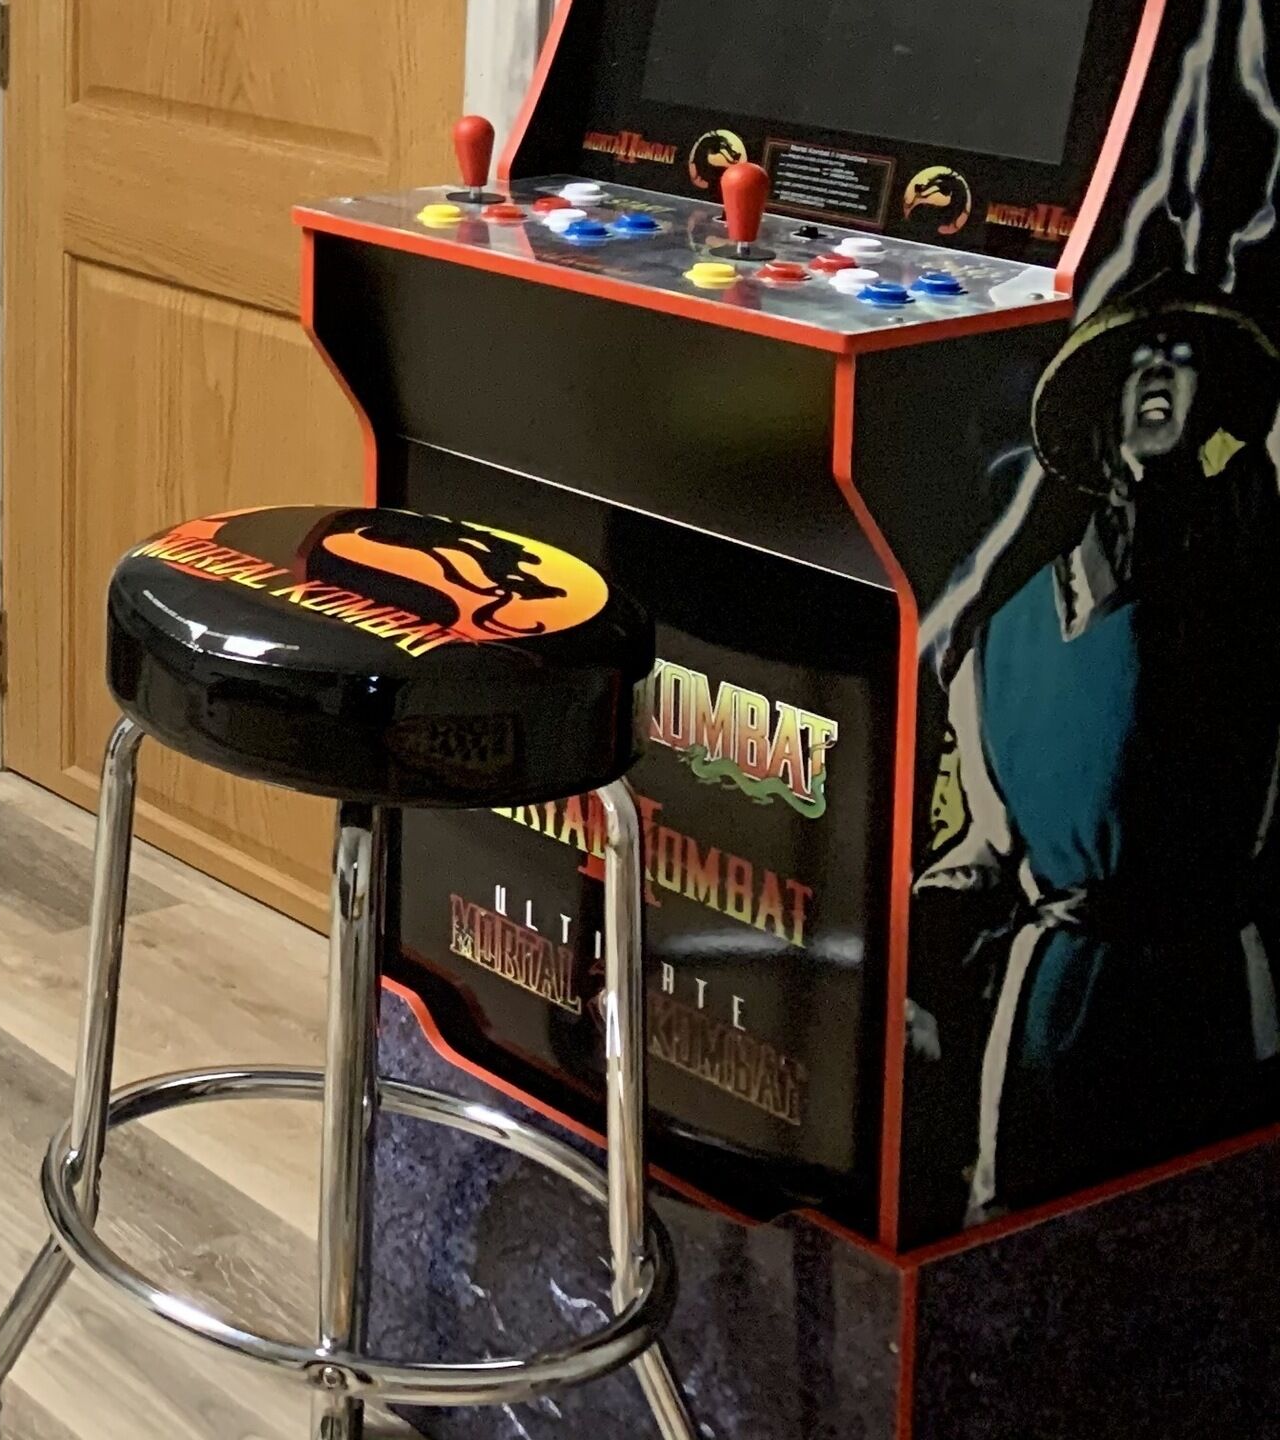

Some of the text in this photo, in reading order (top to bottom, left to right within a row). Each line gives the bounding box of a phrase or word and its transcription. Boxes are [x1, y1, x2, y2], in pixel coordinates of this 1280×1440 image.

[132, 533, 480, 658] MORTAL KOMBAT
[645, 824, 814, 949] OMBAT
